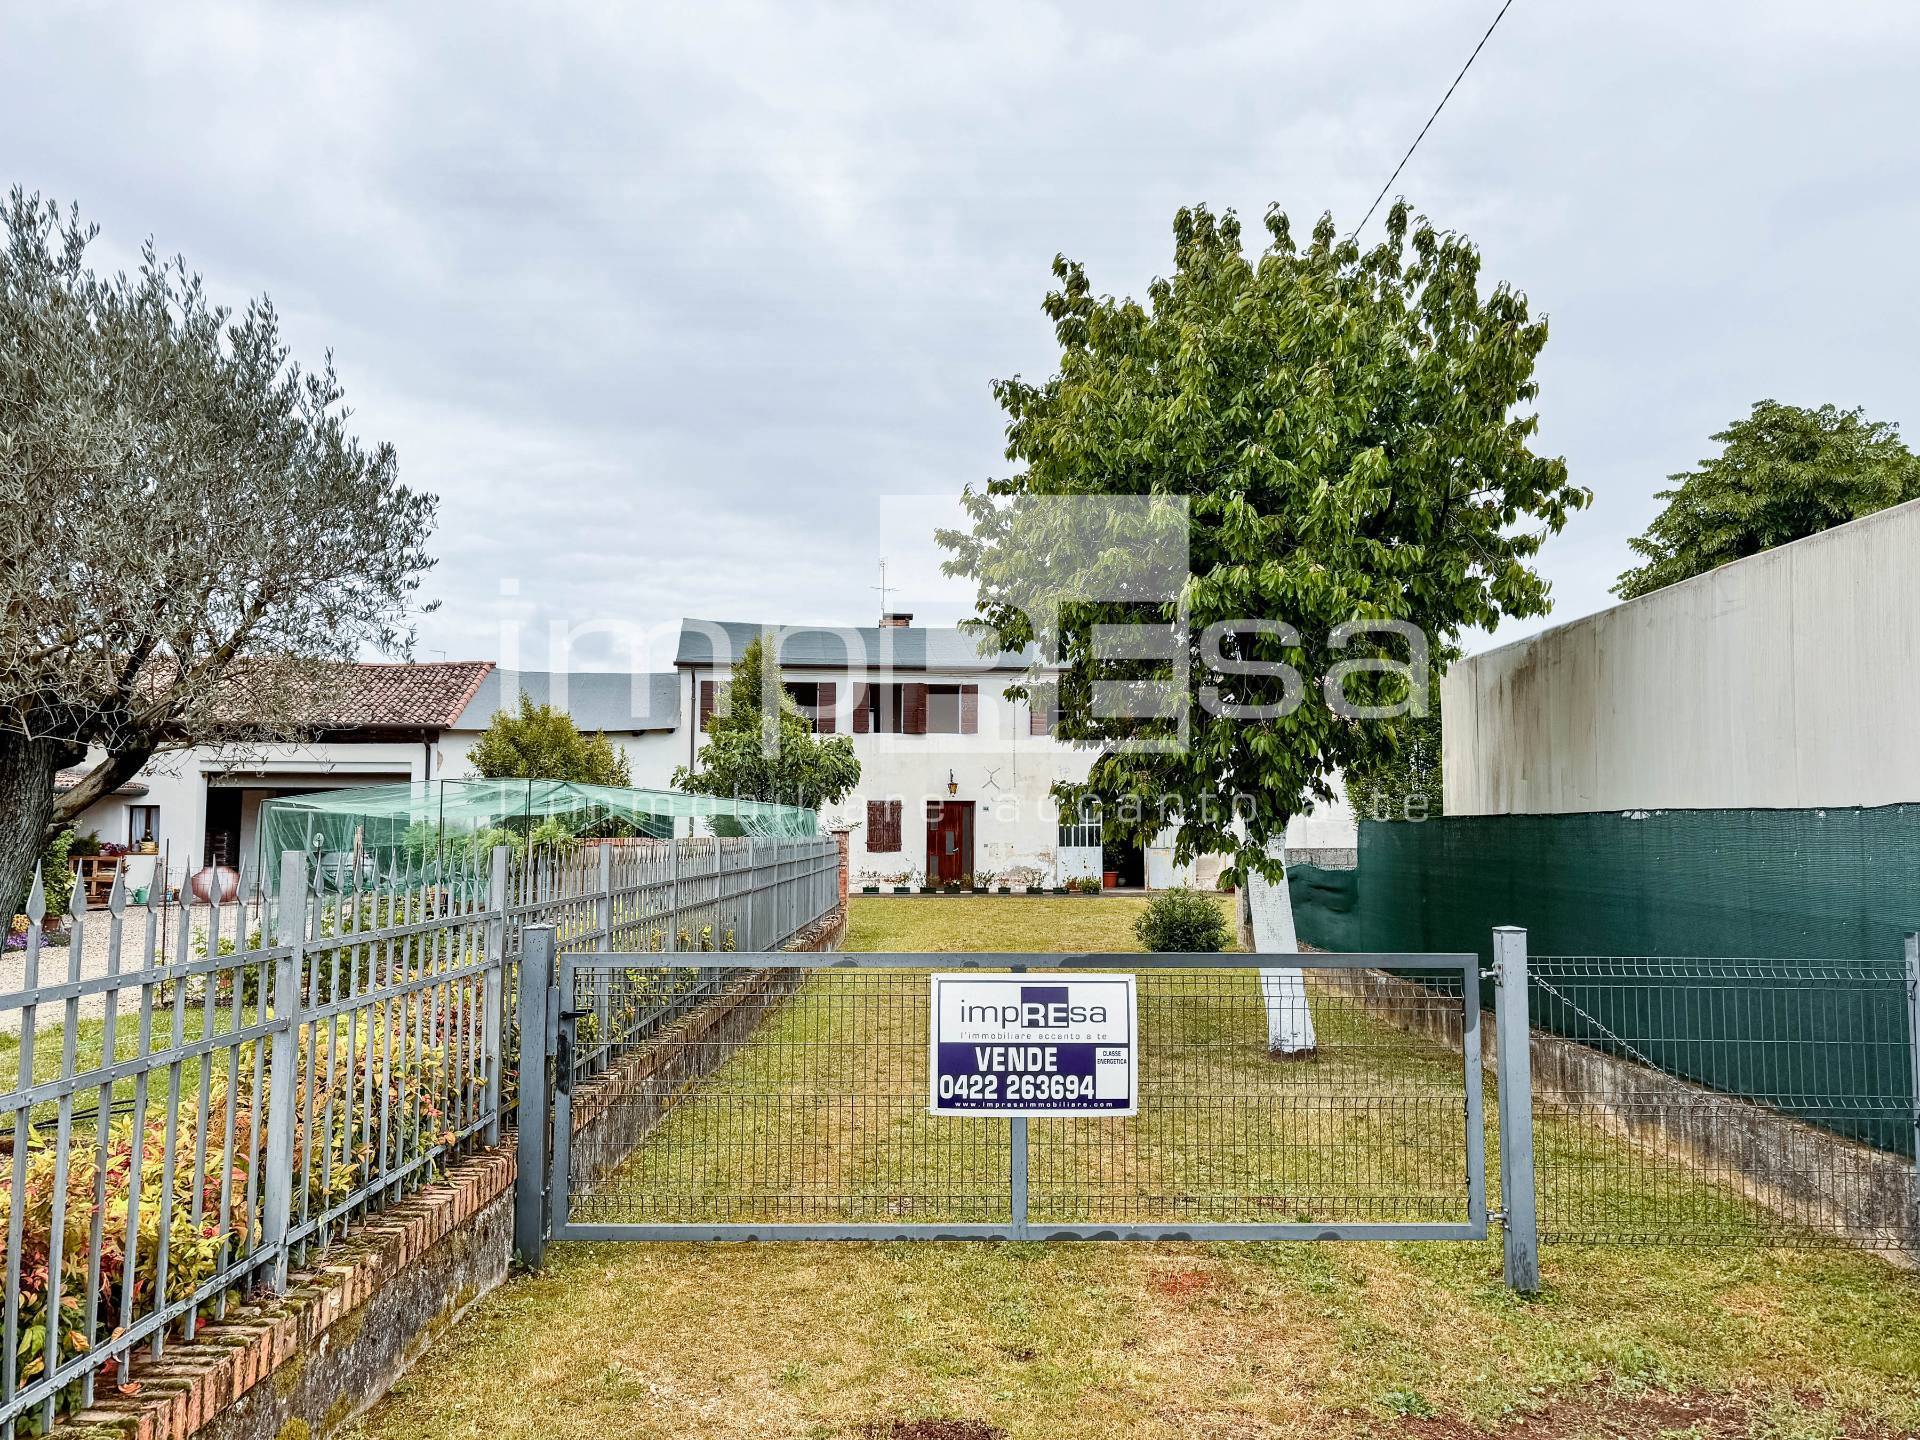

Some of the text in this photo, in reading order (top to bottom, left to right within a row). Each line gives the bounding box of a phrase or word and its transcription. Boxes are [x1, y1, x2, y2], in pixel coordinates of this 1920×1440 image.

[960, 999, 1107, 1029] impREsa
[960, 1032, 1032, 1040] l'immobiliare
[975, 1046, 1058, 1072] VENDE
[940, 1074, 1095, 1100] 0422 263694
